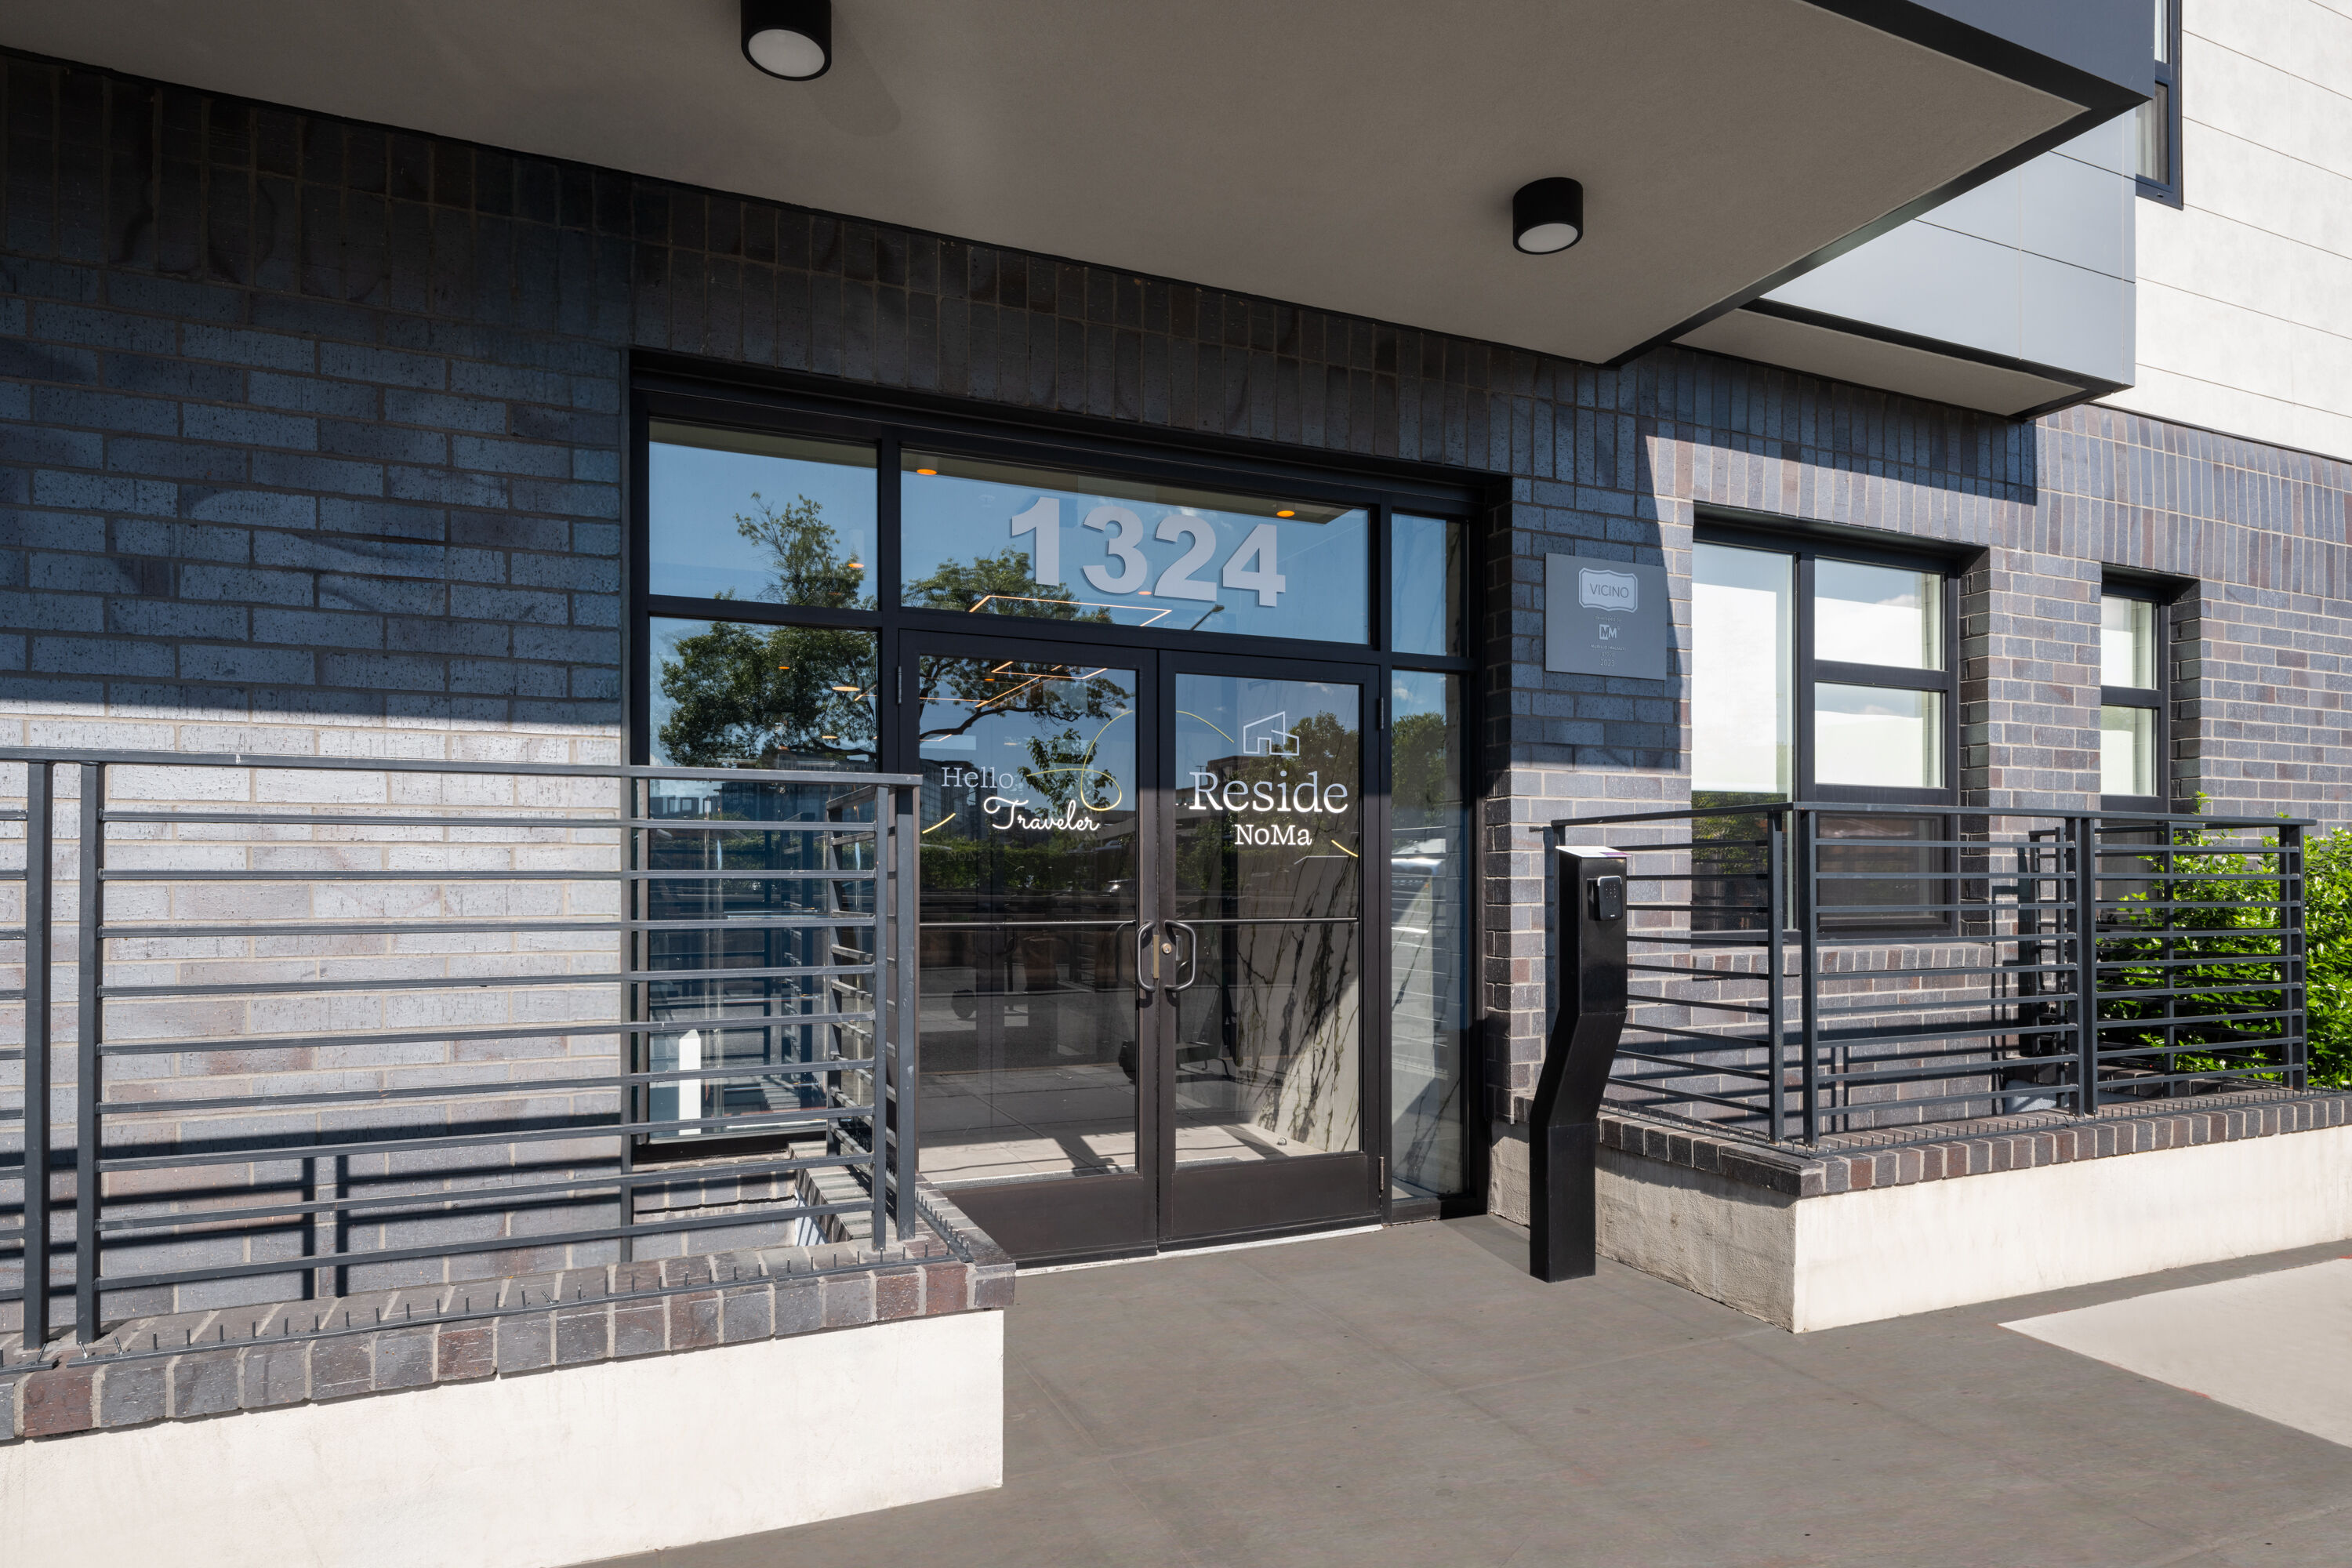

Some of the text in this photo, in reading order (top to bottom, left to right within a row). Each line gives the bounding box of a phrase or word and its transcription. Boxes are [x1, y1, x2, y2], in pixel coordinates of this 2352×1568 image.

[1011, 496, 1286, 607] 1324
[1590, 583, 1629, 598] VICINO
[941, 766, 1014, 789] Hello
[1189, 770, 1348, 814] Reside
[983, 796, 1100, 831] Traveler
[1234, 824, 1312, 845] NoMa
